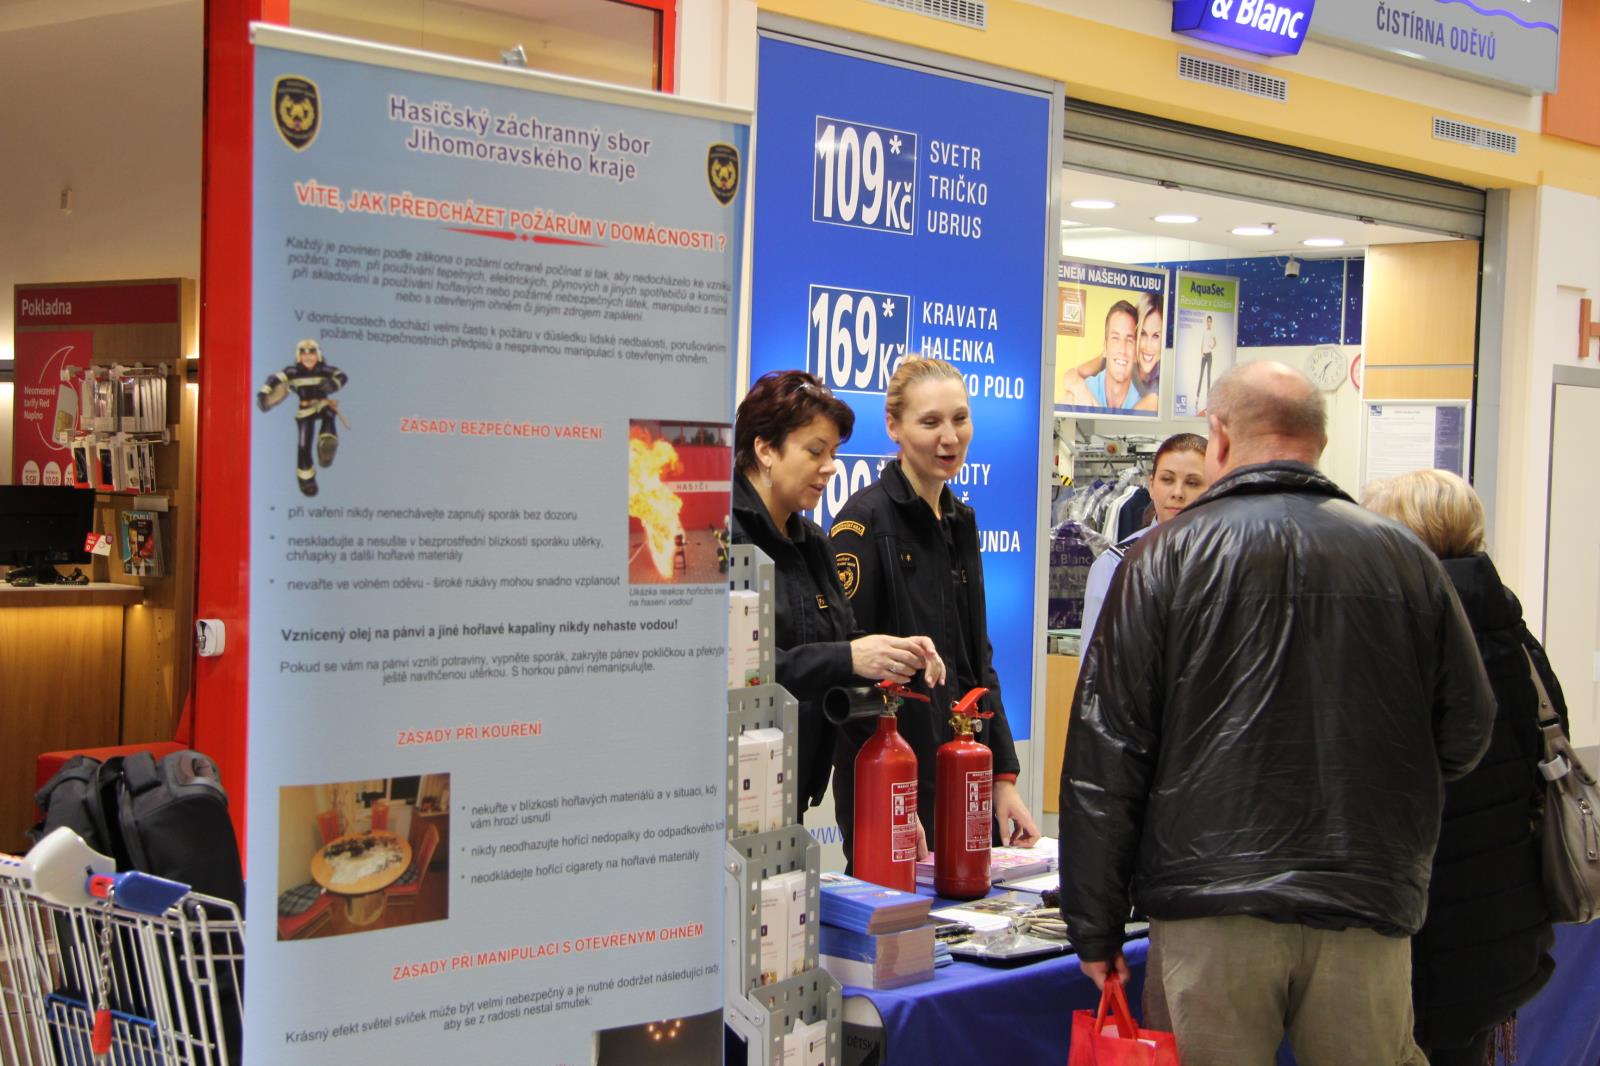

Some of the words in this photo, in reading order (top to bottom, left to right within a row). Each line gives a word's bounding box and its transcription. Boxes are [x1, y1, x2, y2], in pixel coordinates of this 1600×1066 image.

[1211, 0, 1229, 18] &
[1235, 0, 1304, 38] Blanc
[1377, 2, 1445, 47] ČISTÍRNA
[1450, 26, 1496, 60] ODĚVŮ
[389, 97, 489, 132] Hasičský
[496, 119, 600, 152] záchranný
[607, 132, 650, 154] sbor
[407, 130, 582, 171] Jihomoravského
[588, 150, 635, 181] kraje
[930, 140, 981, 171] SVETR
[929, 174, 987, 206] TRIČKO
[296, 183, 343, 210] VÍTE,
[350, 192, 384, 211] JAK
[390, 195, 504, 226] PŘEDCHÁZET
[510, 209, 592, 238] POŽÁRŮM
[597, 222, 608, 238] V
[610, 222, 714, 250] DOMÁCNOSTI
[718, 234, 726, 250] ?
[886, 181, 912, 230] Kč
[927, 210, 982, 239] UBRUS
[1058, 265, 1085, 280] ENEM
[1088, 268, 1128, 286] NAŠEHO
[1129, 274, 1161, 291] KLUBU
[1190, 281, 1225, 297] AquaSec
[22, 298, 71, 318] Pokladna
[923, 301, 998, 331] KRAVATA
[921, 335, 994, 364] HALENKA
[984, 375, 1024, 400] POLO
[401, 418, 456, 432] ZÁSADY
[460, 422, 549, 435] BEZPEČNÉHO
[555, 426, 602, 437] VAŘENÍ
[281, 628, 345, 642] Vznícený
[349, 627, 370, 641] olej
[374, 629, 389, 638] na
[392, 625, 424, 640] pánvi
[438, 625, 458, 639] jiné
[462, 624, 504, 635] hořlavé
[508, 622, 555, 637] kapaliny
[559, 621, 589, 635] nikdy
[592, 620, 636, 632] nehaste
[640, 619, 677, 631] vodou!
[398, 729, 452, 744] ZÁSADY
[456, 727, 476, 738] PŘI
[481, 722, 542, 736] KOUŘENÍ
[471, 802, 507, 814] nekuřte
[519, 797, 558, 811] blízkosti
[561, 793, 607, 808] hořlavých
[610, 789, 654, 804] materiálů
[470, 817, 490, 828] vám
[493, 814, 518, 826] hrozí
[471, 843, 496, 857] nikdy
[499, 838, 558, 853] neodhazujte
[562, 834, 588, 848] hořící
[591, 829, 640, 845] nedopalky
[658, 820, 714, 839] odpadkového
[470, 867, 532, 883] neodkládejte
[535, 863, 562, 876] hořící
[565, 860, 602, 876] cigarety
[606, 860, 618, 869] na
[620, 854, 655, 868] hořlavé
[658, 850, 698, 864] materiály
[393, 961, 446, 979] ZÁSADY
[451, 955, 472, 966] PŘI
[476, 944, 559, 964] MANIPULACI
[563, 941, 570, 952] S
[575, 931, 656, 950] OTEVŘENÝM
[660, 924, 703, 939] OHNĚM
[285, 1024, 328, 1042] Krásný
[331, 1020, 358, 1034] efekt
[361, 1013, 391, 1029] světel
[394, 1008, 426, 1023] svíček
[429, 1004, 456, 1018] může
[459, 1001, 474, 1015] být
[477, 995, 502, 1010] velmi
[505, 986, 564, 1006] nebezpečný
[585, 978, 613, 993] nutné
[617, 973, 652, 988] dodržet
[655, 965, 702, 983] následující
[443, 1016, 461, 1030] aby
[487, 1006, 520, 1022] radosti
[523, 1001, 552, 1016] nestal
